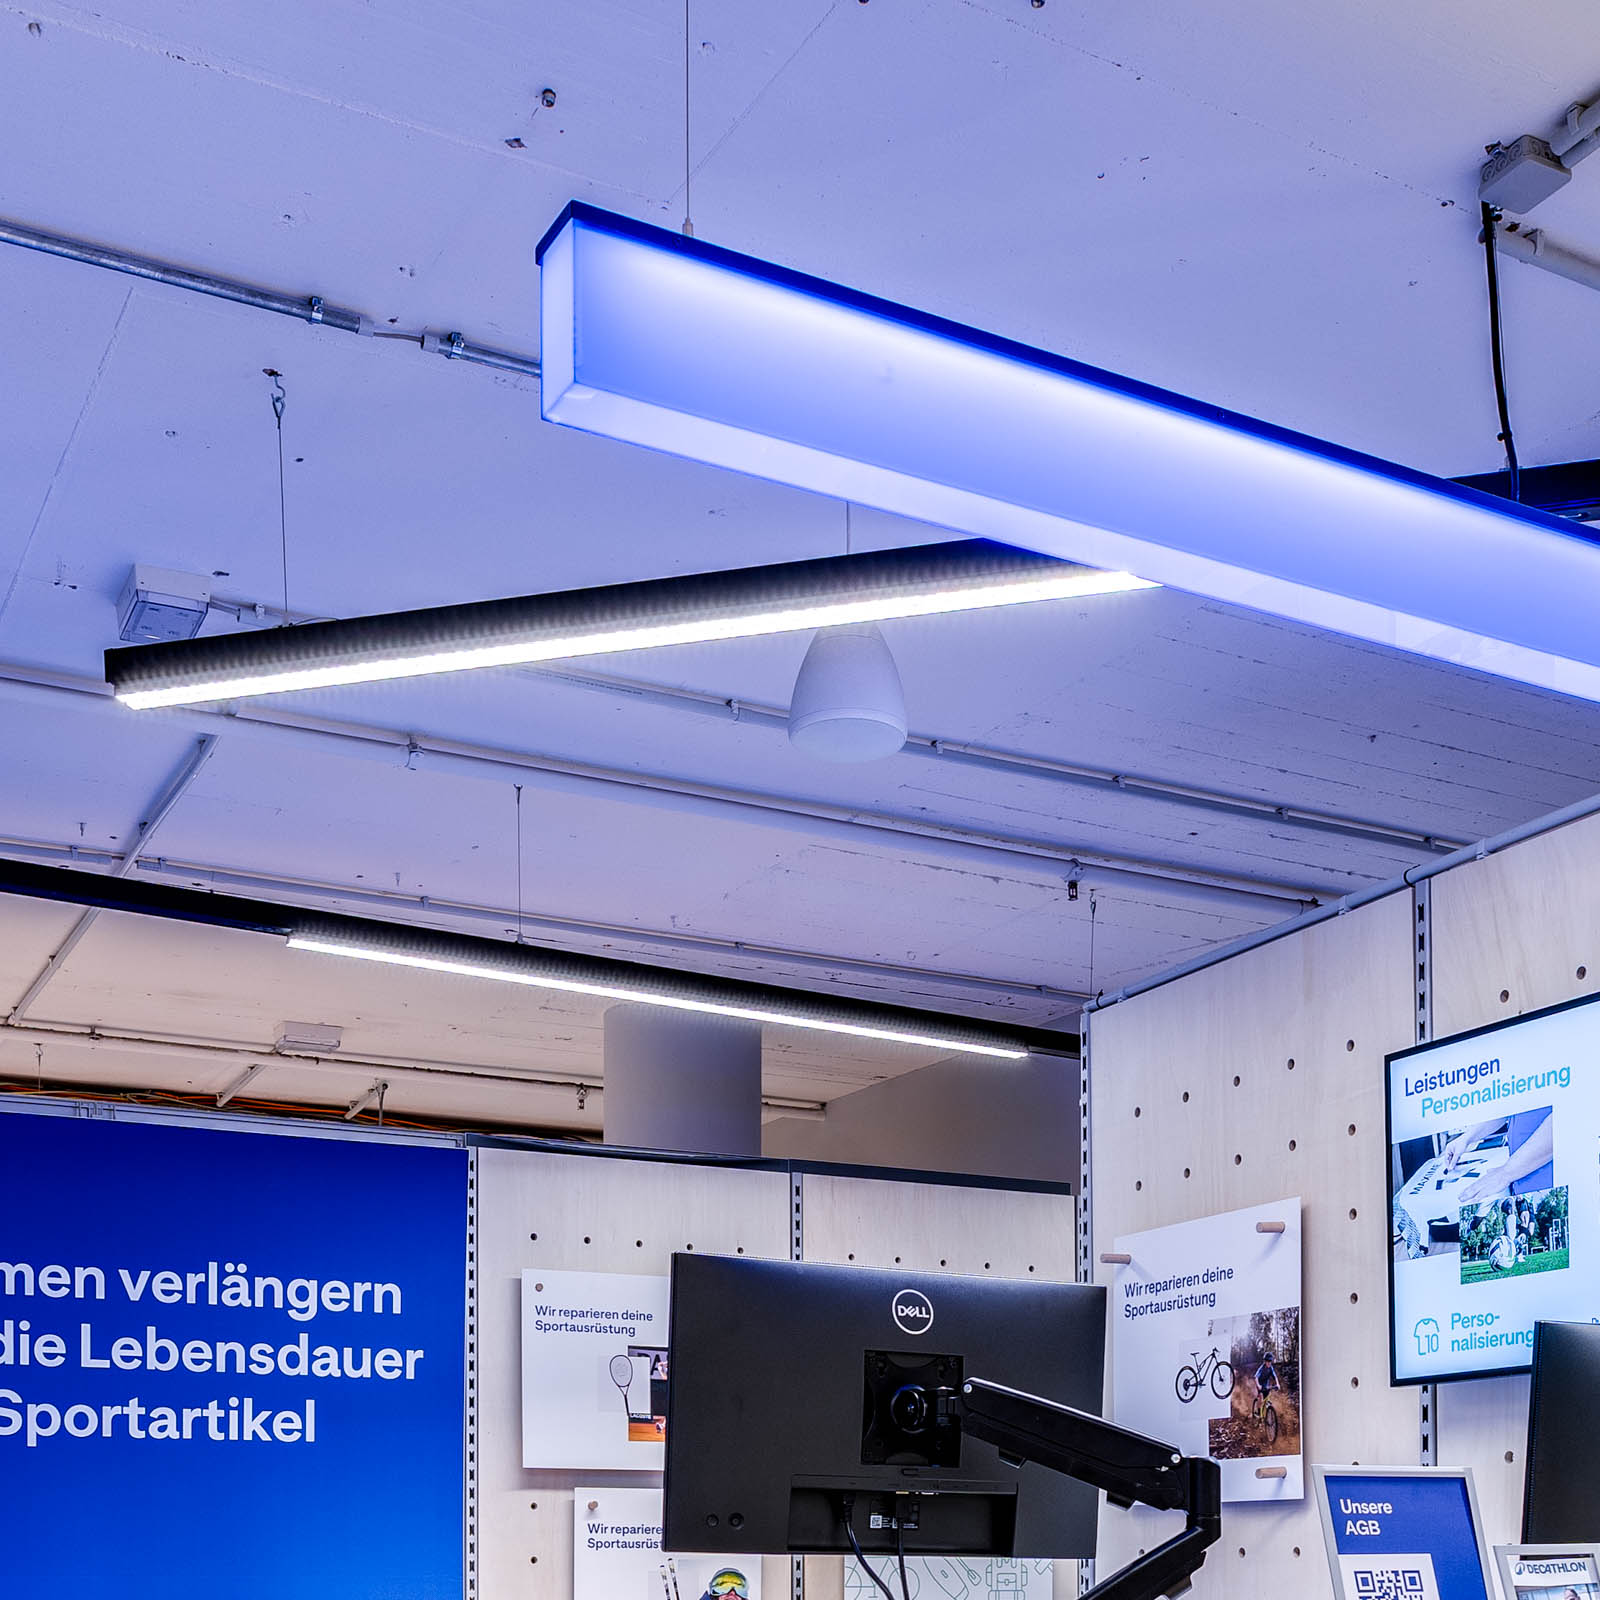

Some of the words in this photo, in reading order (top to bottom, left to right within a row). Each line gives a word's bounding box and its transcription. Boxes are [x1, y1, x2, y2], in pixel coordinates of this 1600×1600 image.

[1405, 1058, 1501, 1097] Leistungen
[1421, 1065, 1571, 1118] Personalisierung
[118, 1259, 403, 1322] verlängern
[1124, 1282, 1143, 1298] Wir
[1144, 1275, 1200, 1296] reparieren
[1201, 1266, 1234, 1284] deine
[535, 1305, 557, 1317] Wir
[558, 1307, 619, 1320] reparieren
[621, 1309, 653, 1322] deine
[897, 1305, 930, 1318] DELL
[1124, 1292, 1216, 1320] Sportausrüstung
[535, 1320, 636, 1337] Sportausrüstung
[1451, 1313, 1500, 1330] Perso-
[1451, 1330, 1534, 1352] nalisierung
[81, 1322, 424, 1380] Lebensdauer
[1340, 1499, 1393, 1514] Unsere
[587, 1523, 608, 1534] Wir
[1345, 1520, 1381, 1536] AGB
[1526, 1561, 1587, 1575] DECATHLON
